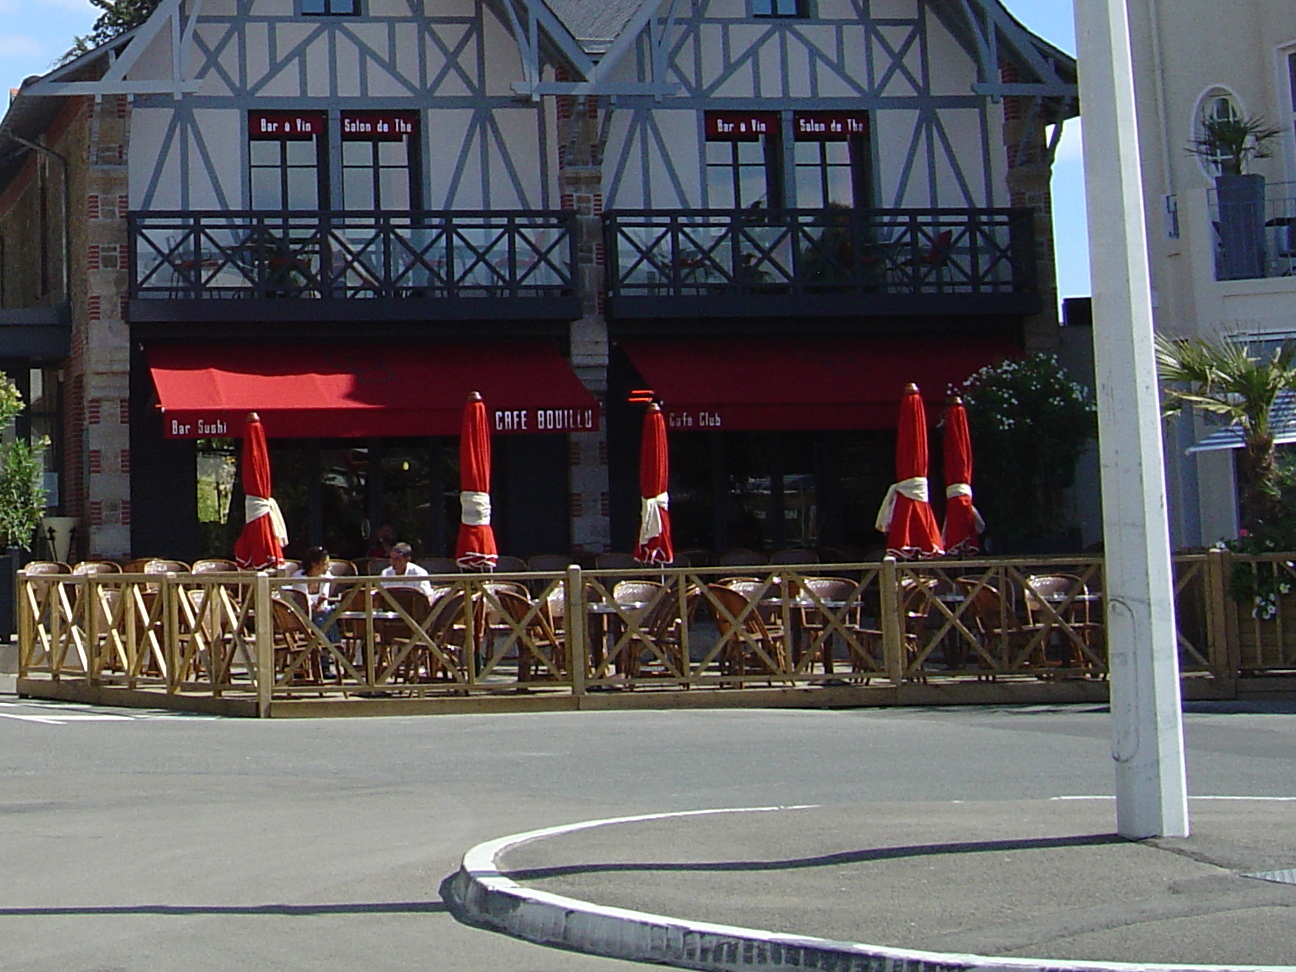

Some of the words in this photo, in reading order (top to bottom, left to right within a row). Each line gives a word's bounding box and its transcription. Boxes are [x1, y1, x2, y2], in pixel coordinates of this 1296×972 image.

[260, 118, 278, 132] Bar
[296, 118, 312, 132] Vin
[344, 118, 372, 132] Salon
[377, 119, 389, 132] de
[717, 118, 735, 132] Bar
[751, 118, 767, 132] Vin
[799, 118, 826, 132] Salon
[495, 410, 527, 430] CAFE
[699, 411, 721, 427] Club
[172, 419, 191, 434] Bar
[198, 419, 227, 434] Sushi
